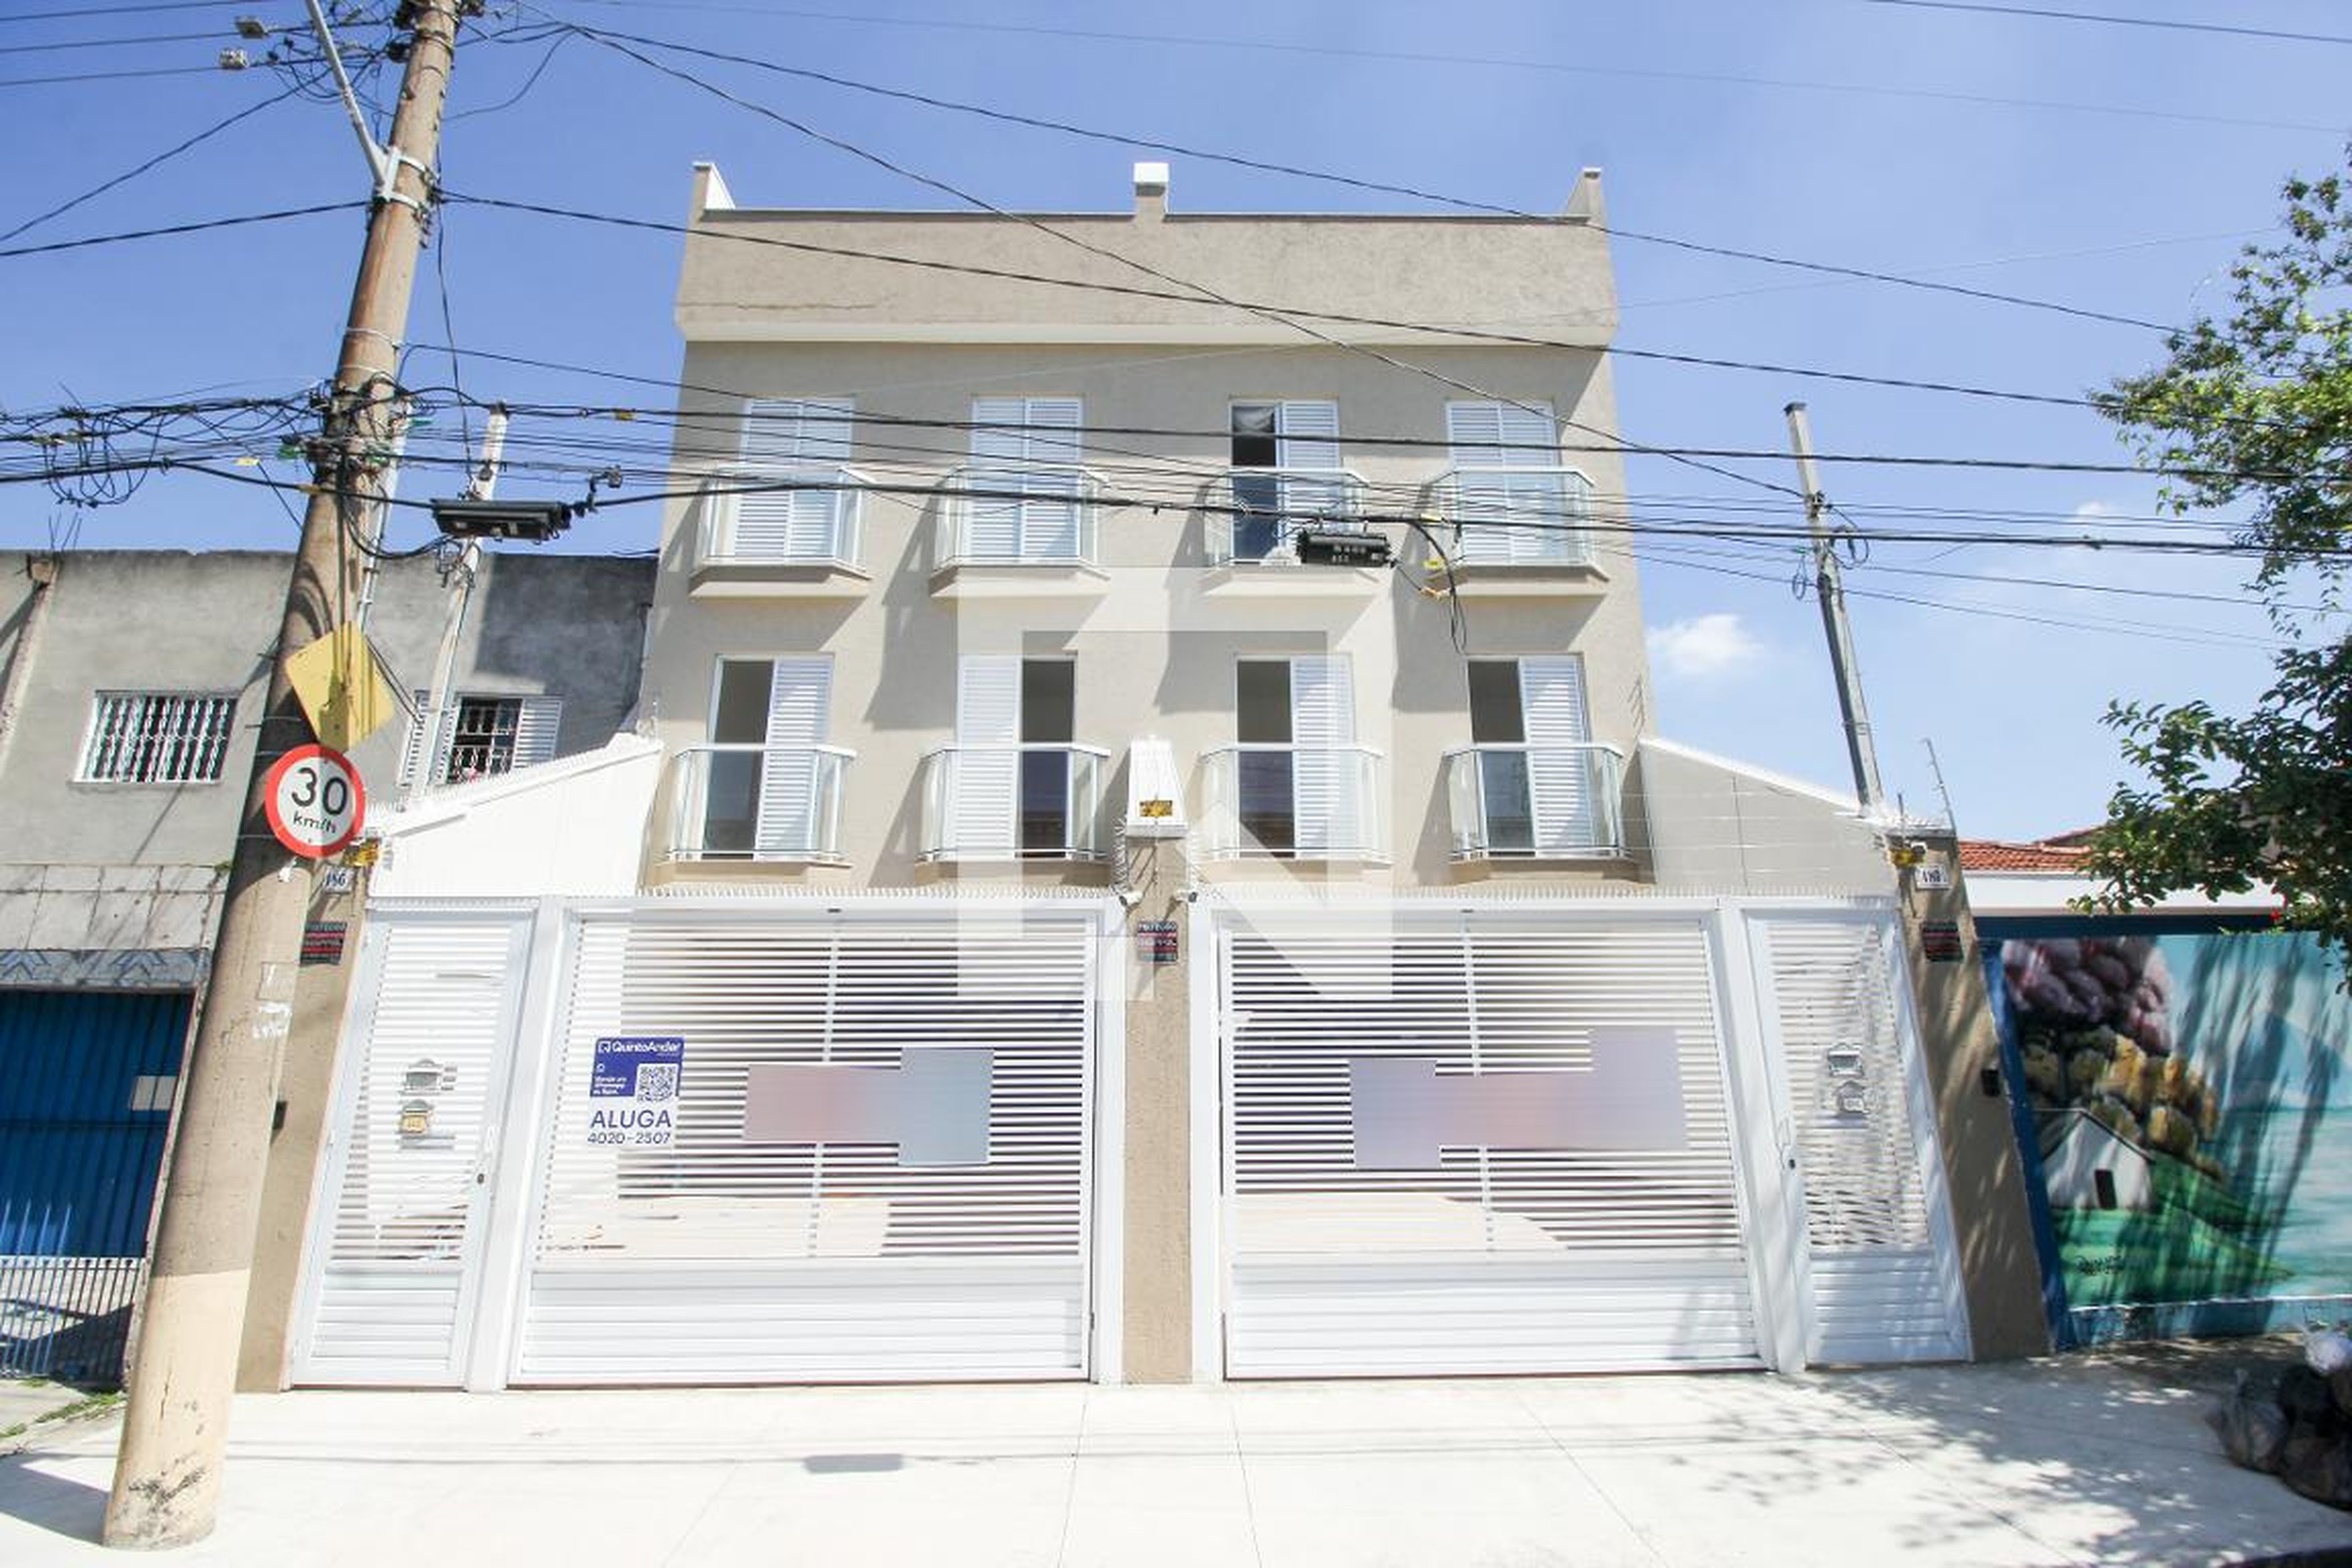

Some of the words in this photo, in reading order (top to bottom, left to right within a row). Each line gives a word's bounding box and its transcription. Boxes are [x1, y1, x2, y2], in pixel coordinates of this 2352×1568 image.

[291, 767, 348, 815] 30
[293, 811, 337, 834] km/h
[590, 1110, 672, 1128] ALUGA
[587, 1133, 671, 1144] 4020-2507
